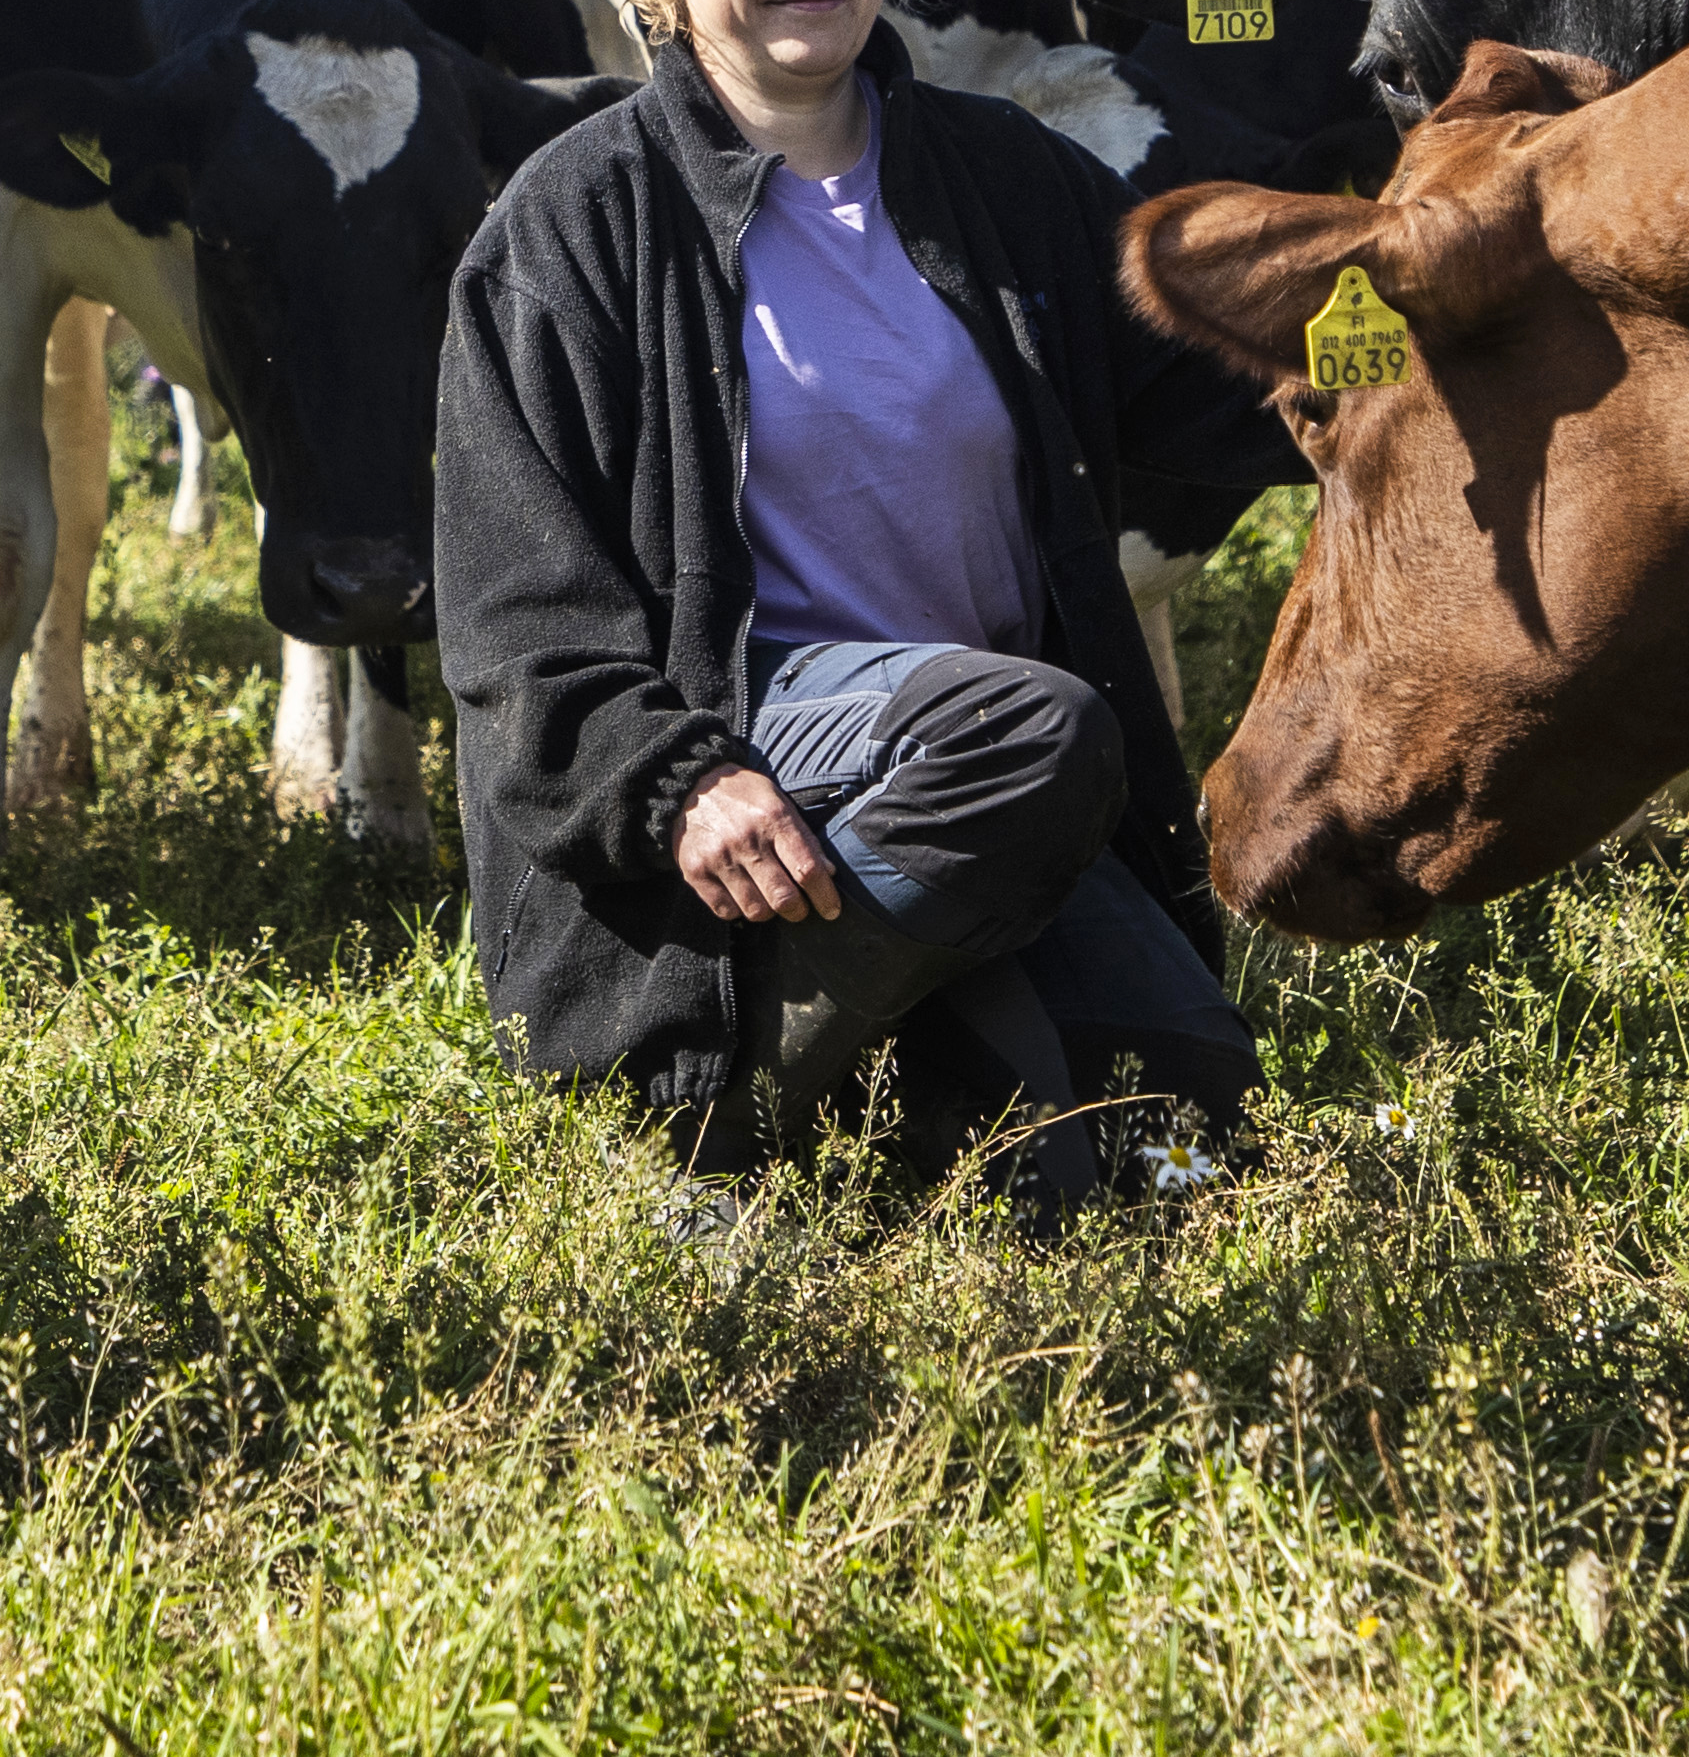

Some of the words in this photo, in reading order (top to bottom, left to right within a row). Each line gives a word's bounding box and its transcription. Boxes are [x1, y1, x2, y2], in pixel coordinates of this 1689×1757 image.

[1195, 11, 1268, 41] 7109
[1352, 315, 1365, 328] FI
[1321, 335, 1339, 350] 012
[1346, 333, 1366, 347] 400
[1372, 331, 1392, 345] 796
[1318, 347, 1406, 387] 0639
